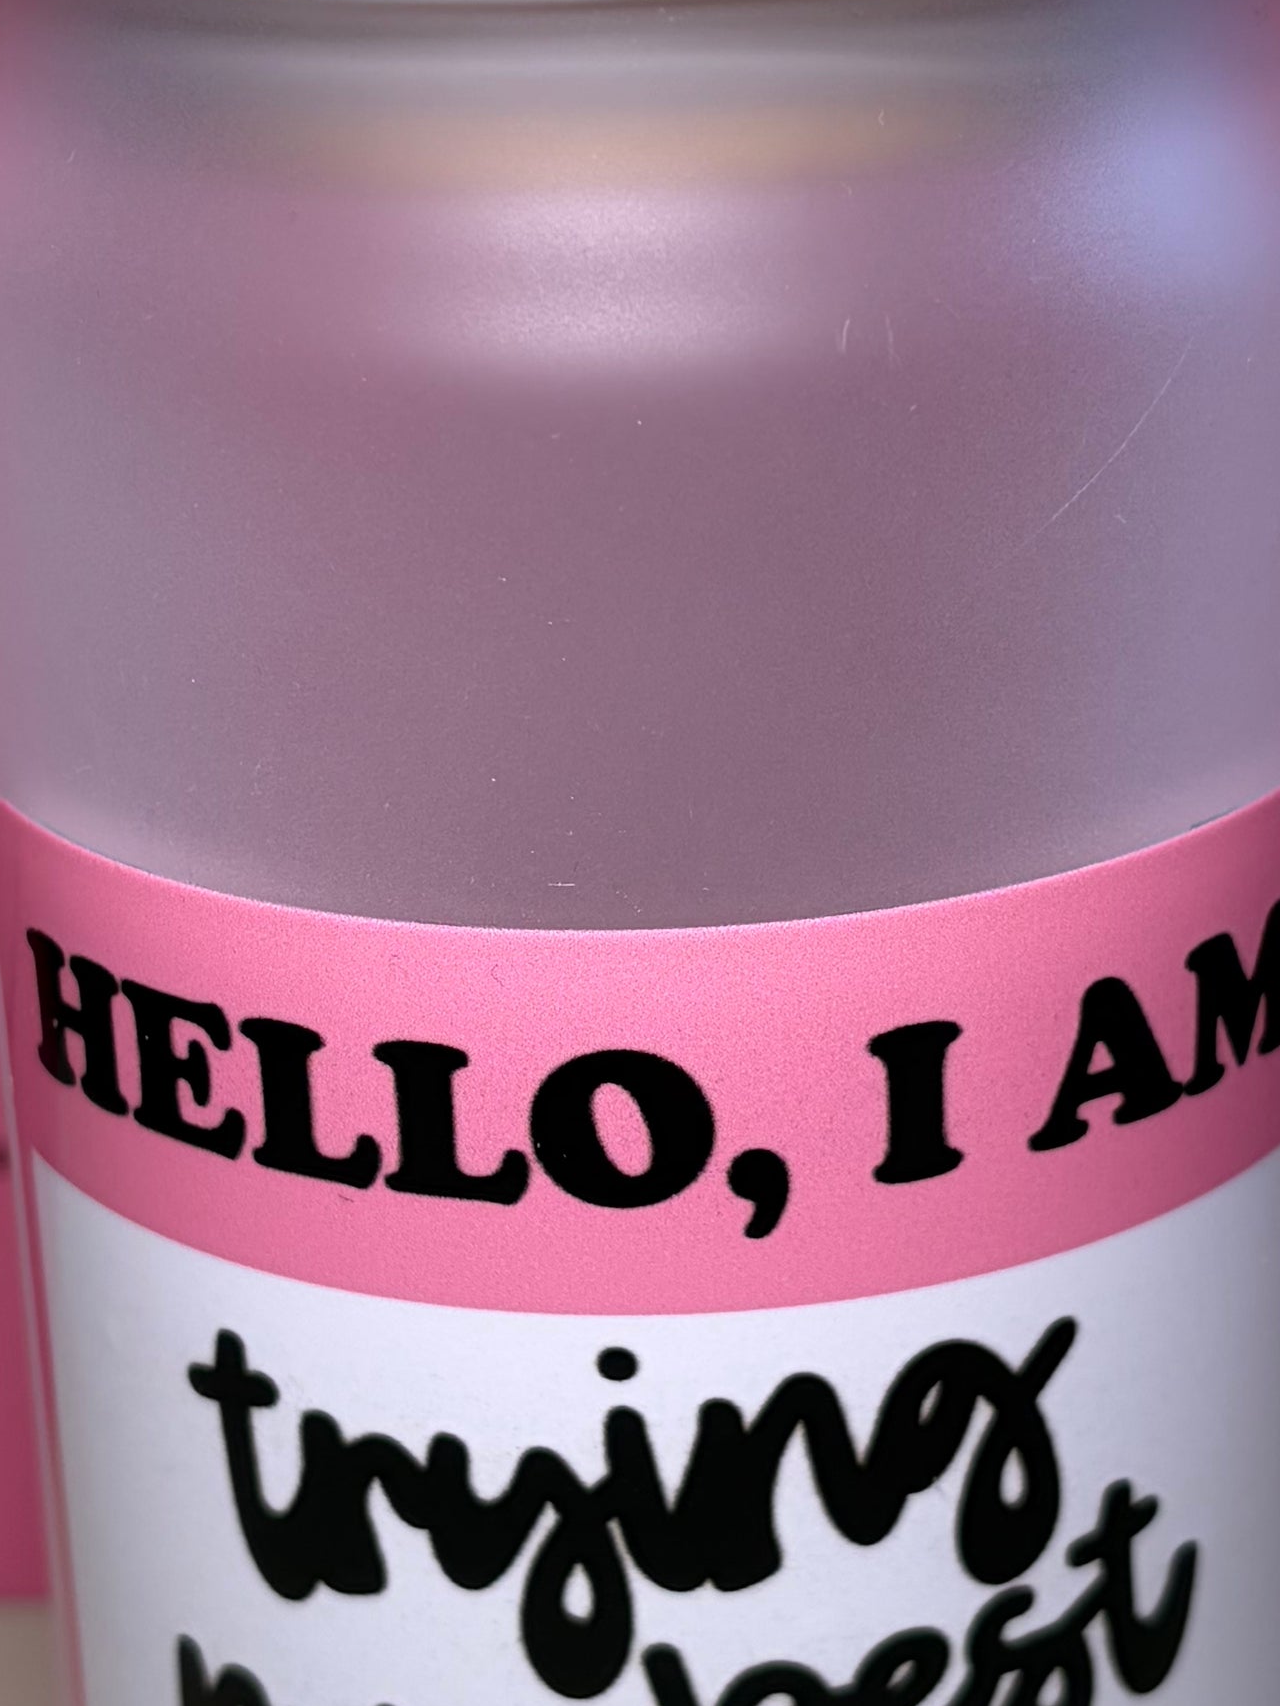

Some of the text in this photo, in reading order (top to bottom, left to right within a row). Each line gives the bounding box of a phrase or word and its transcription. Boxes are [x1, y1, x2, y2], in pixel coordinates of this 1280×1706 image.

[24, 925, 792, 1241] HELLO,
[865, 1019, 966, 1186] I
[186, 1315, 1079, 1702] trying
